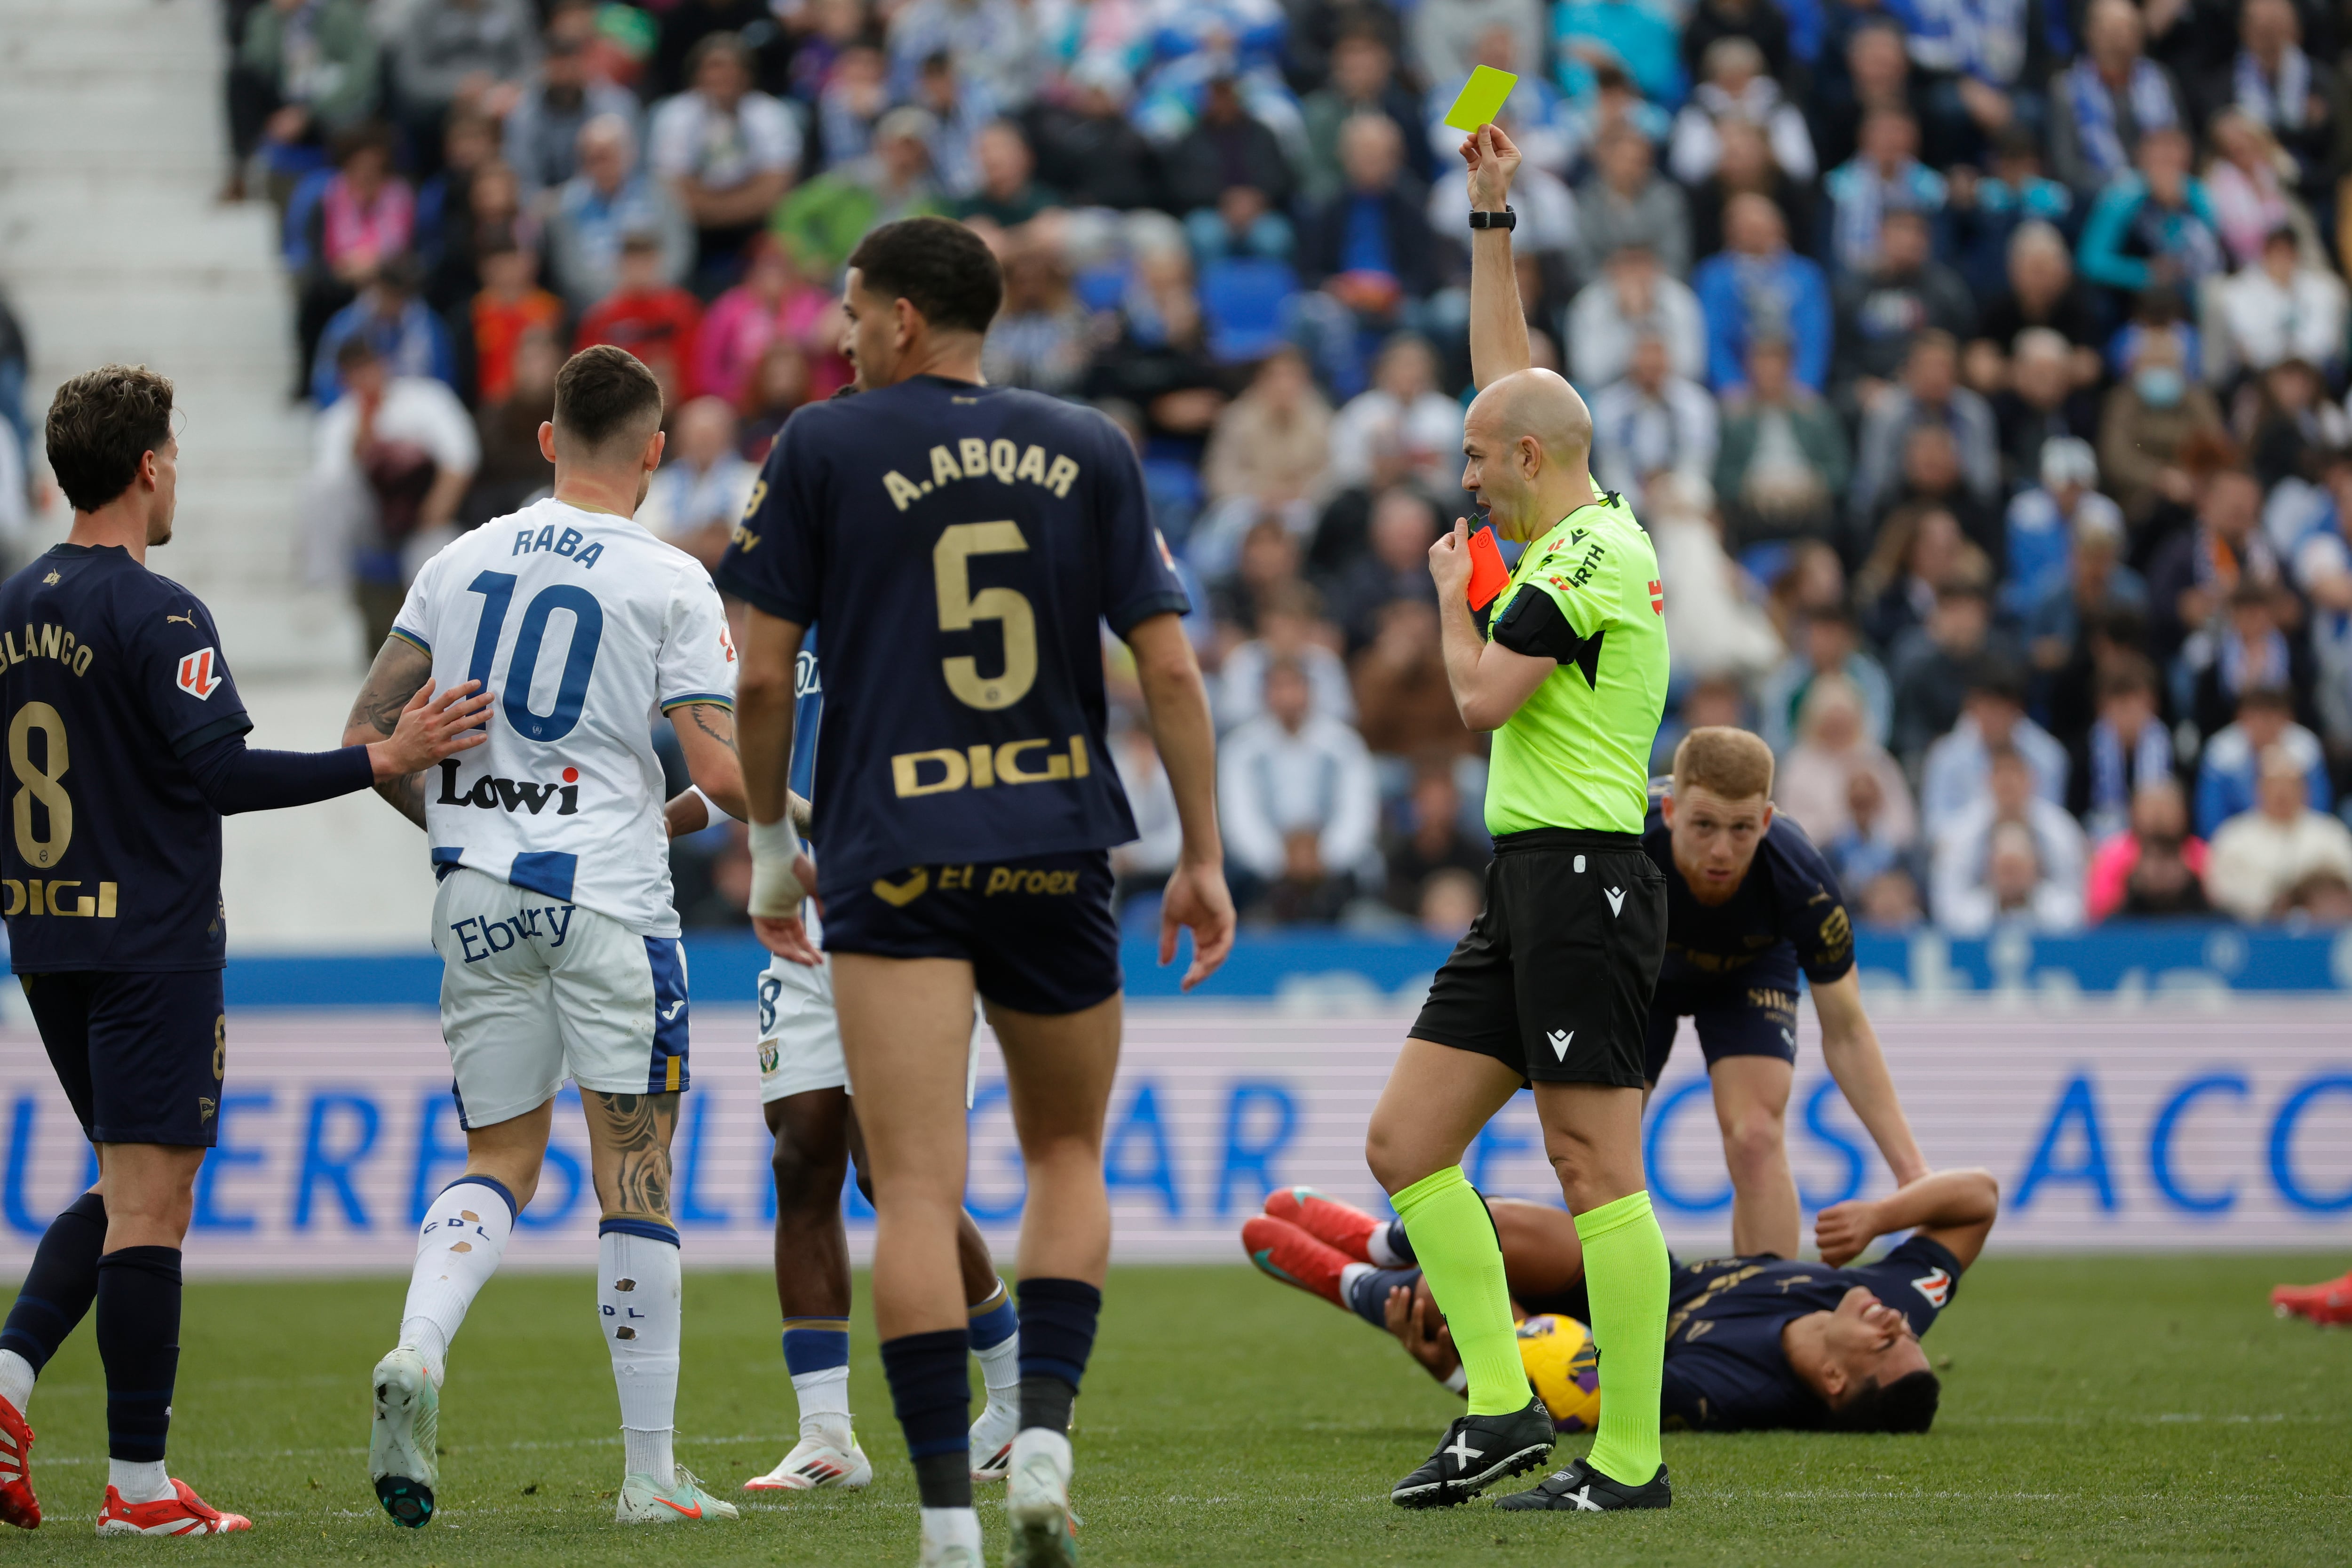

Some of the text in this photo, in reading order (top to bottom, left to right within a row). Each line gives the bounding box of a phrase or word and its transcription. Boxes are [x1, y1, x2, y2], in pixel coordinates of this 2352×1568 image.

[882, 438, 1080, 512] A.ABQAR
[511, 525, 605, 570] RABA
[1565, 544, 1605, 588] RTH
[932, 519, 1038, 711] 5
[467, 569, 604, 743] 10
[8, 701, 73, 868] 8
[436, 758, 579, 815] Lowi
[891, 735, 1090, 799] DIGI
[2, 879, 118, 918] DIGI
[938, 864, 1080, 897] El proex
[450, 905, 576, 963] Ebury
[759, 979, 781, 1035] 8
[213, 1014, 226, 1080] 8
[2, 1087, 587, 1238] UERES
